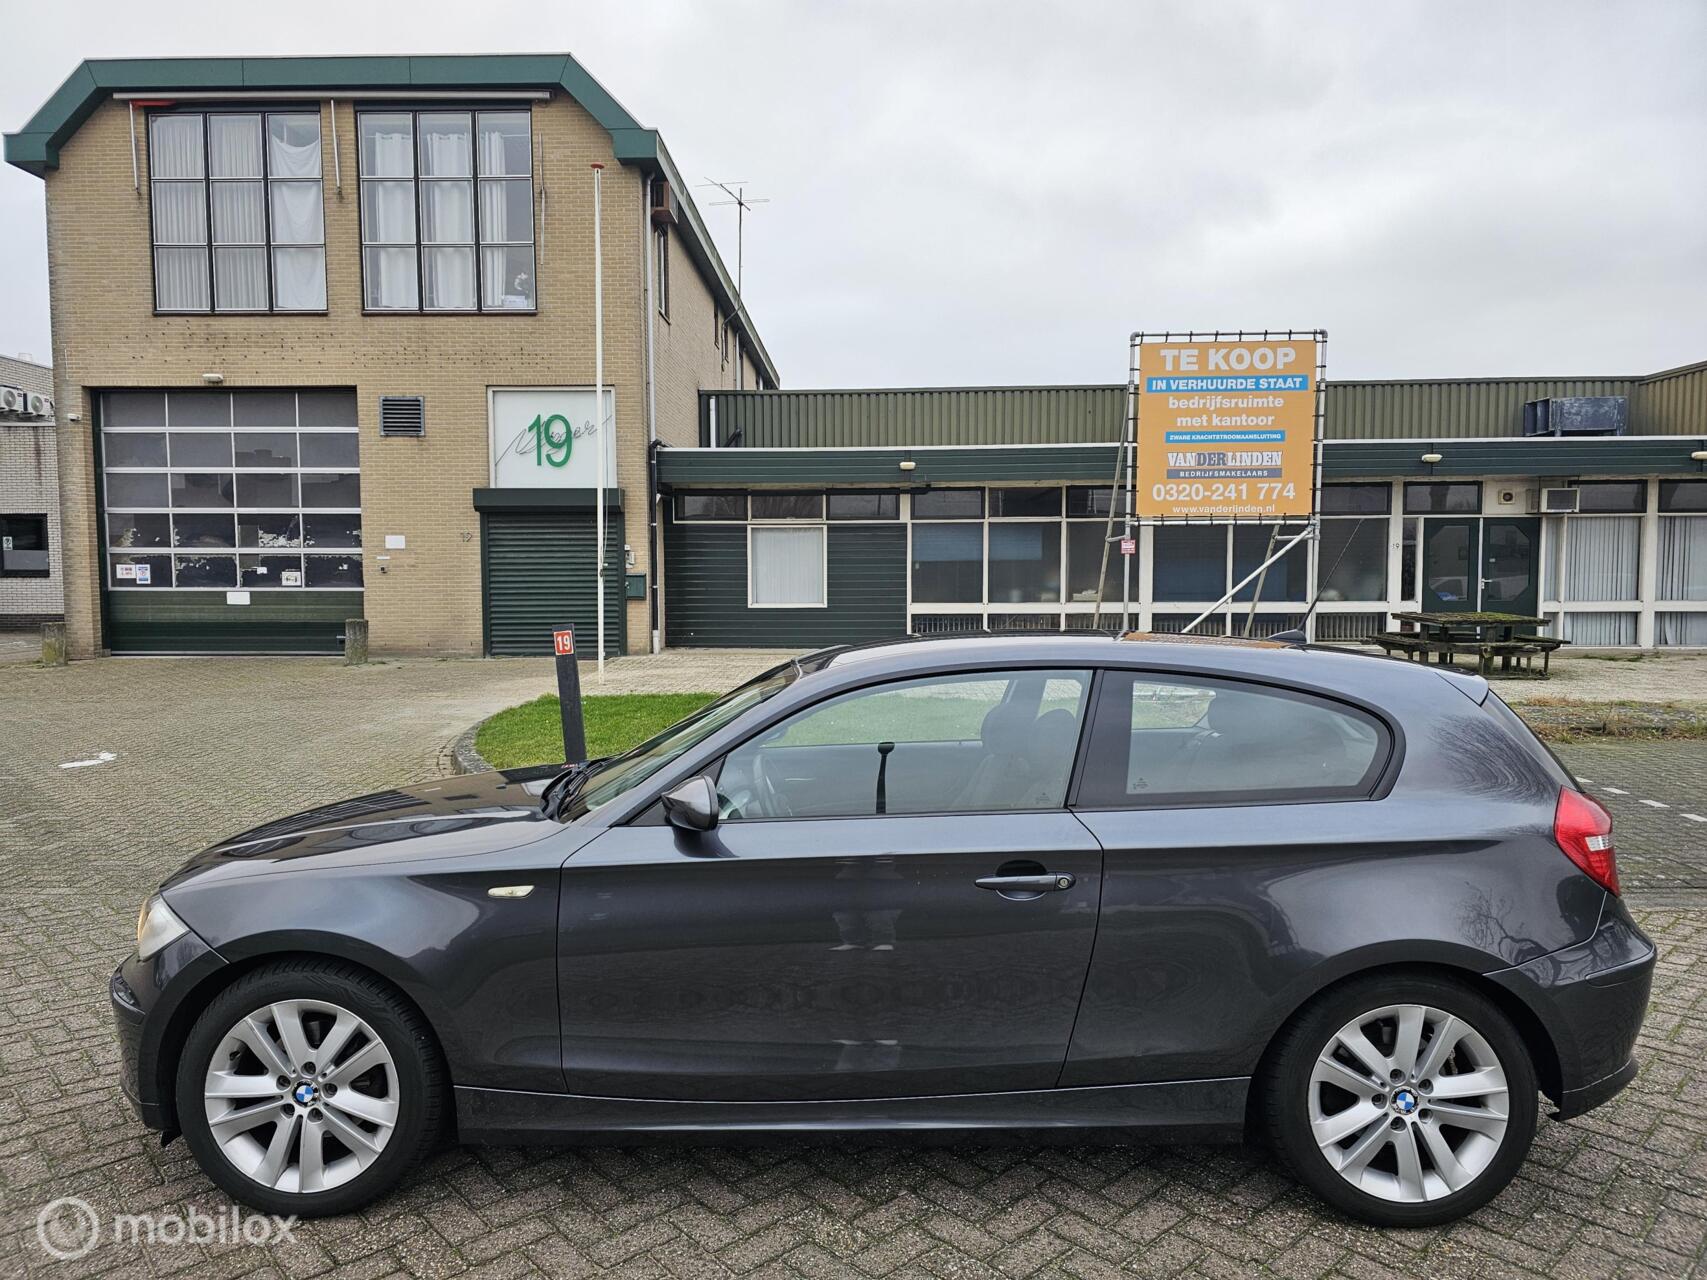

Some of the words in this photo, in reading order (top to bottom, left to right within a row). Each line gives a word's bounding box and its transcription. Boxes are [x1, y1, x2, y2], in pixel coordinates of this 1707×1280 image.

[1159, 348, 1199, 371] TE
[1208, 347, 1296, 371] KOOP
[1152, 379, 1166, 390] IN
[1170, 378, 1255, 390] VERHUURDE
[1259, 377, 1302, 389] STAAT
[1168, 395, 1284, 410] bedrijfsruimte
[1176, 414, 1207, 426] met
[1212, 413, 1275, 426] kantoor
[528, 414, 572, 468] 19
[1152, 483, 1248, 500] 0320-241
[1257, 482, 1296, 500] 774
[1172, 503, 1275, 513] www.vanderlinden.nl
[556, 635, 570, 651] 19
